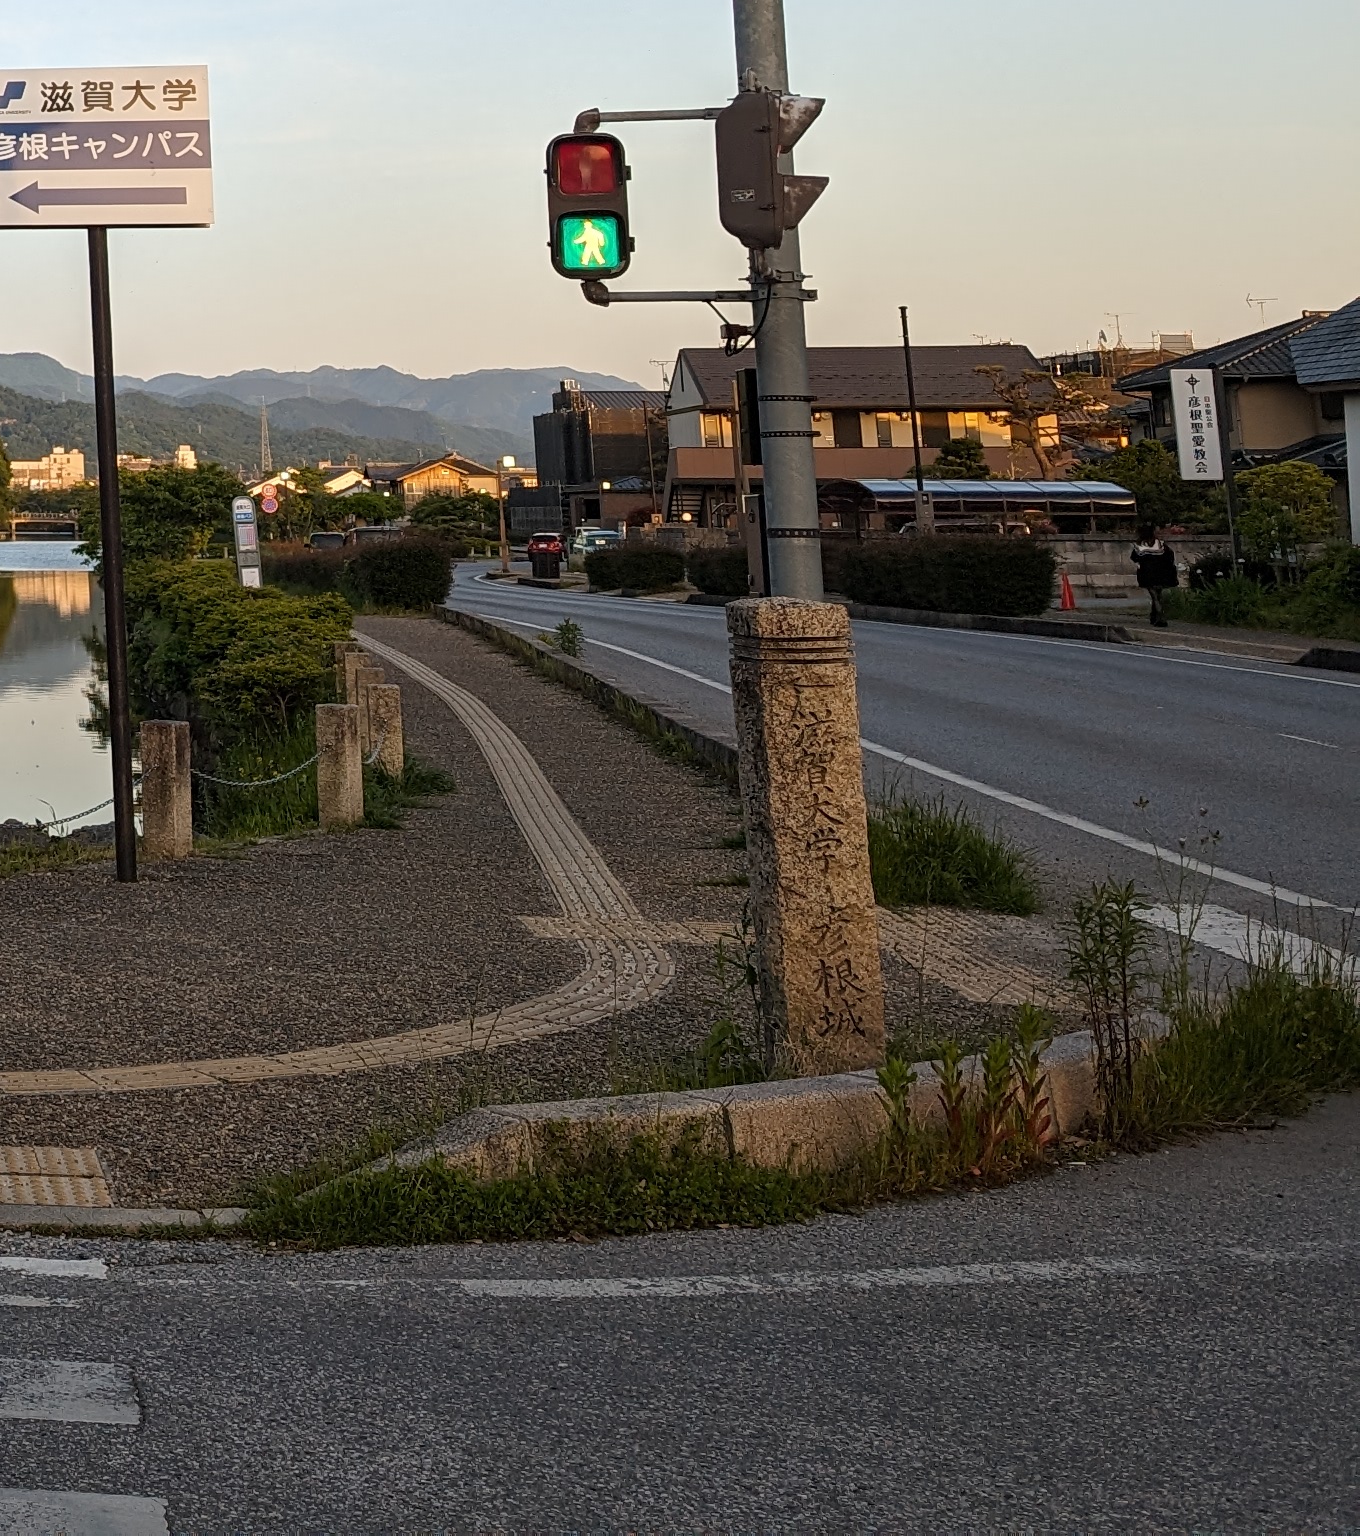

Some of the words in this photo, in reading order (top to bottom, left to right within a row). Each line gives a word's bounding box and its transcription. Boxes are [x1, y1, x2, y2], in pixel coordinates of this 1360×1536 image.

[39, 78, 198, 114] 滋賀大学
[1189, 396, 1208, 473] 彦根聖愛教会
[812, 904, 867, 1039] 彦根城
